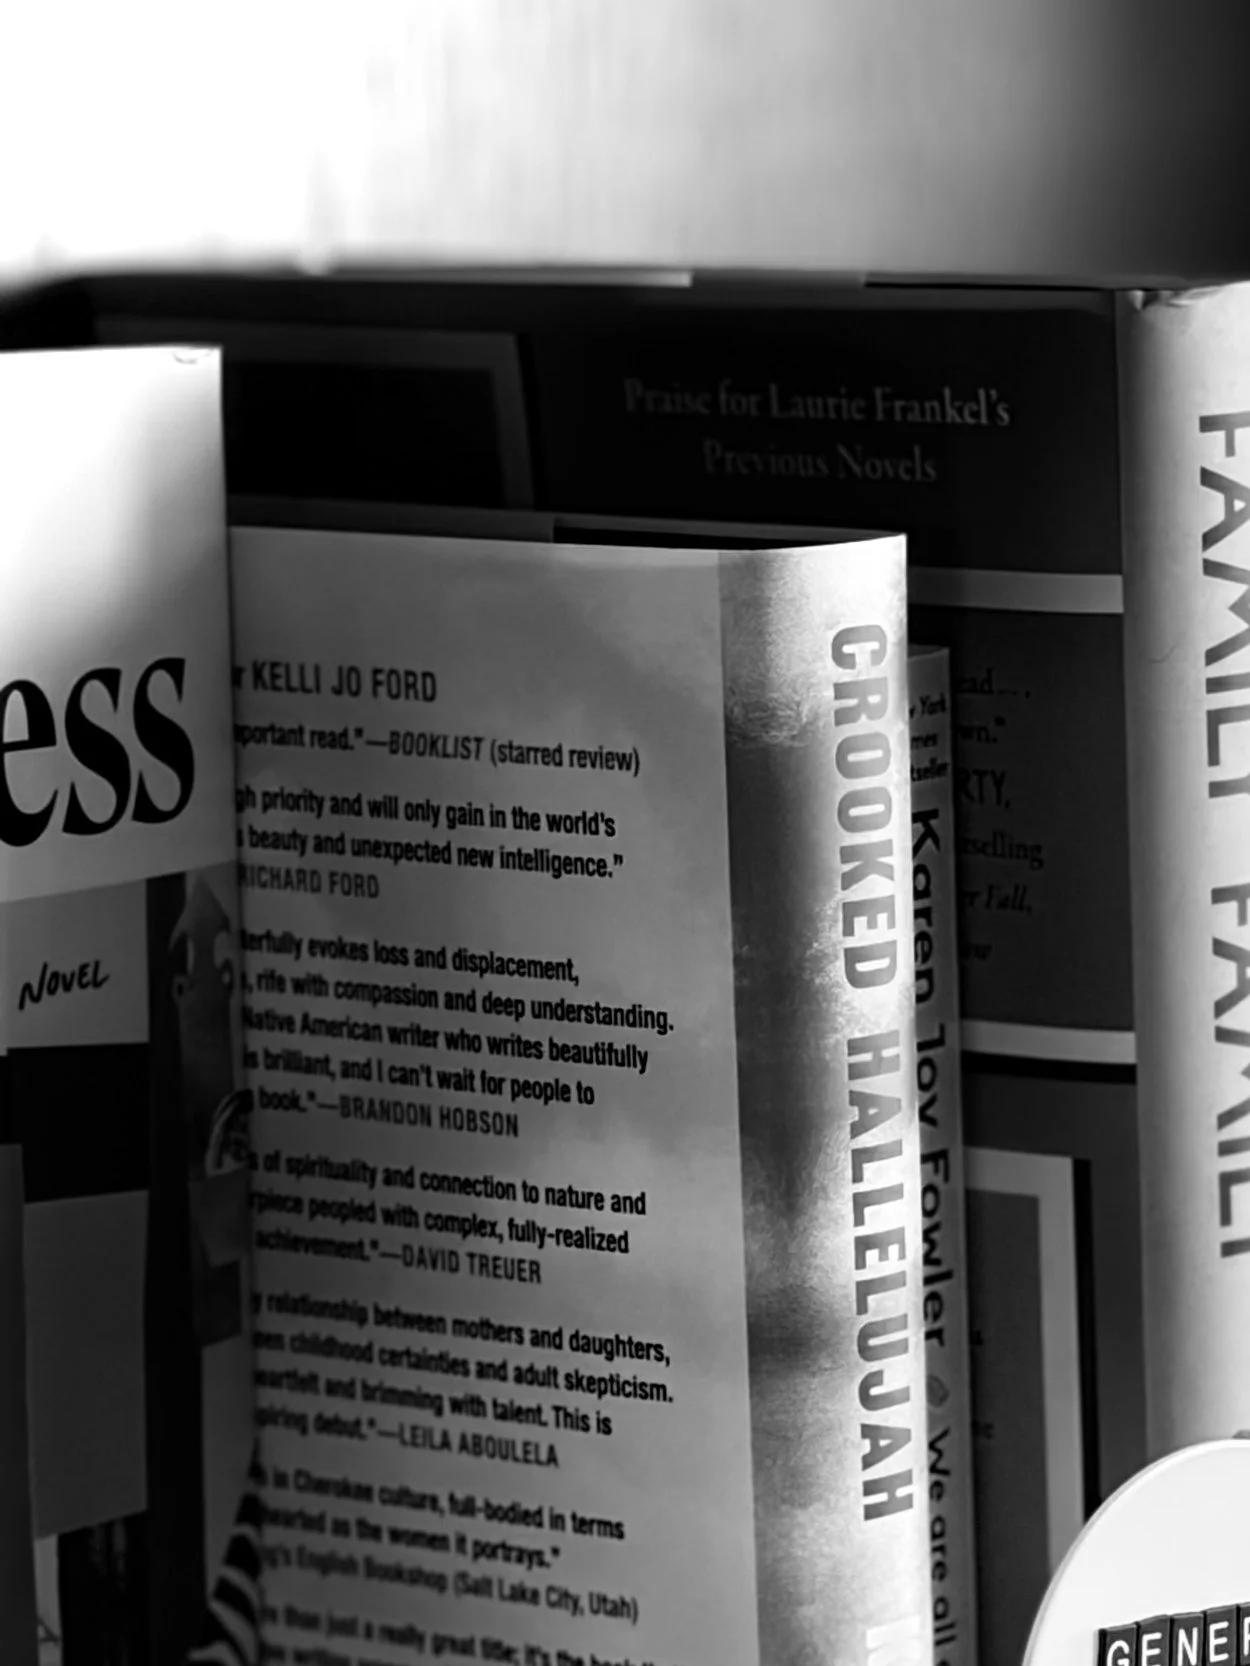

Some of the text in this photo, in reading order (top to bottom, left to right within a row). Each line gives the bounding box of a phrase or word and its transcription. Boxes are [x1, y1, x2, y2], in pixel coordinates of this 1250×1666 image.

[622, 378, 1011, 427] Praise for Laurie Frankel's
[704, 438, 937, 482] Previous Novels
[252, 662, 320, 693] KELLI
[331, 666, 361, 697] JO
[372, 668, 436, 702] FORD
[491, 741, 563, 766] (starred
[569, 747, 640, 775] review)
[262, 789, 325, 817] priority
[330, 794, 362, 816] and
[368, 796, 398, 819] will
[404, 800, 440, 827] only
[446, 803, 484, 829] gain
[512, 806, 540, 831] the
[546, 812, 615, 836] world's
[249, 826, 308, 856] beauty
[313, 833, 345, 855] and
[351, 839, 452, 864] unexpected
[457, 848, 494, 867] new
[500, 848, 623, 877] intelligence."
[329, 871, 379, 898] FORD
[911, 808, 941, 1003] Karen
[308, 937, 369, 961] evokes
[374, 940, 409, 966] loss
[414, 947, 447, 969] and
[452, 949, 579, 983] displacement,
[257, 970, 286, 993] rife
[291, 975, 328, 996] with
[334, 982, 438, 1007] compassion
[444, 990, 476, 1012] and
[482, 992, 525, 1021] deep
[531, 1000, 673, 1034] understanding.
[300, 1013, 382, 1041] American
[387, 1024, 439, 1047] writer
[444, 1029, 482, 1053] who
[487, 1035, 543, 1059] writes
[549, 1039, 648, 1072] beautifully
[263, 1050, 336, 1078] brilliant,
[341, 1059, 372, 1081] and
[388, 1065, 432, 1087] can't
[437, 1069, 475, 1091] wait
[480, 1070, 506, 1095] for
[511, 1079, 571, 1104] people
[831, 624, 914, 1522] CROOKED HALLELUJAH
[440, 1108, 518, 1136] HOBSON
[286, 1157, 377, 1187] spirituality
[383, 1167, 415, 1189] and
[420, 1173, 516, 1199] connection
[545, 1186, 604, 1210] nature
[611, 1192, 646, 1215] and
[381, 1206, 419, 1228] with
[424, 1213, 503, 1241] complex,
[508, 1219, 629, 1252] fully-realized
[919, 1147, 949, 1349] Fowler
[466, 1252, 541, 1282] TREUER
[374, 1305, 446, 1333] between
[452, 1319, 524, 1344] mothers
[530, 1328, 563, 1350] and
[569, 1332, 670, 1364] daughters,
[379, 1348, 470, 1376] certainties
[476, 1361, 508, 1382] and
[514, 1364, 559, 1388] adult
[565, 1371, 673, 1401] skepticism.
[449, 1395, 487, 1417] with
[492, 1399, 548, 1426] talent.
[552, 1406, 590, 1432] This
[459, 1434, 558, 1466] ABOULELA
[926, 1428, 952, 1501] We
[449, 1494, 543, 1527] full-bodied
[571, 1513, 624, 1539] terms
[388, 1528, 449, 1551] women
[473, 1541, 560, 1569] portrays."
[929, 1514, 951, 1581] are
[454, 1572, 493, 1597] (Salt
[498, 1580, 540, 1605] Lake
[546, 1586, 584, 1615] City,
[589, 1593, 638, 1622] Utah)
[932, 1598, 959, 1646] all
